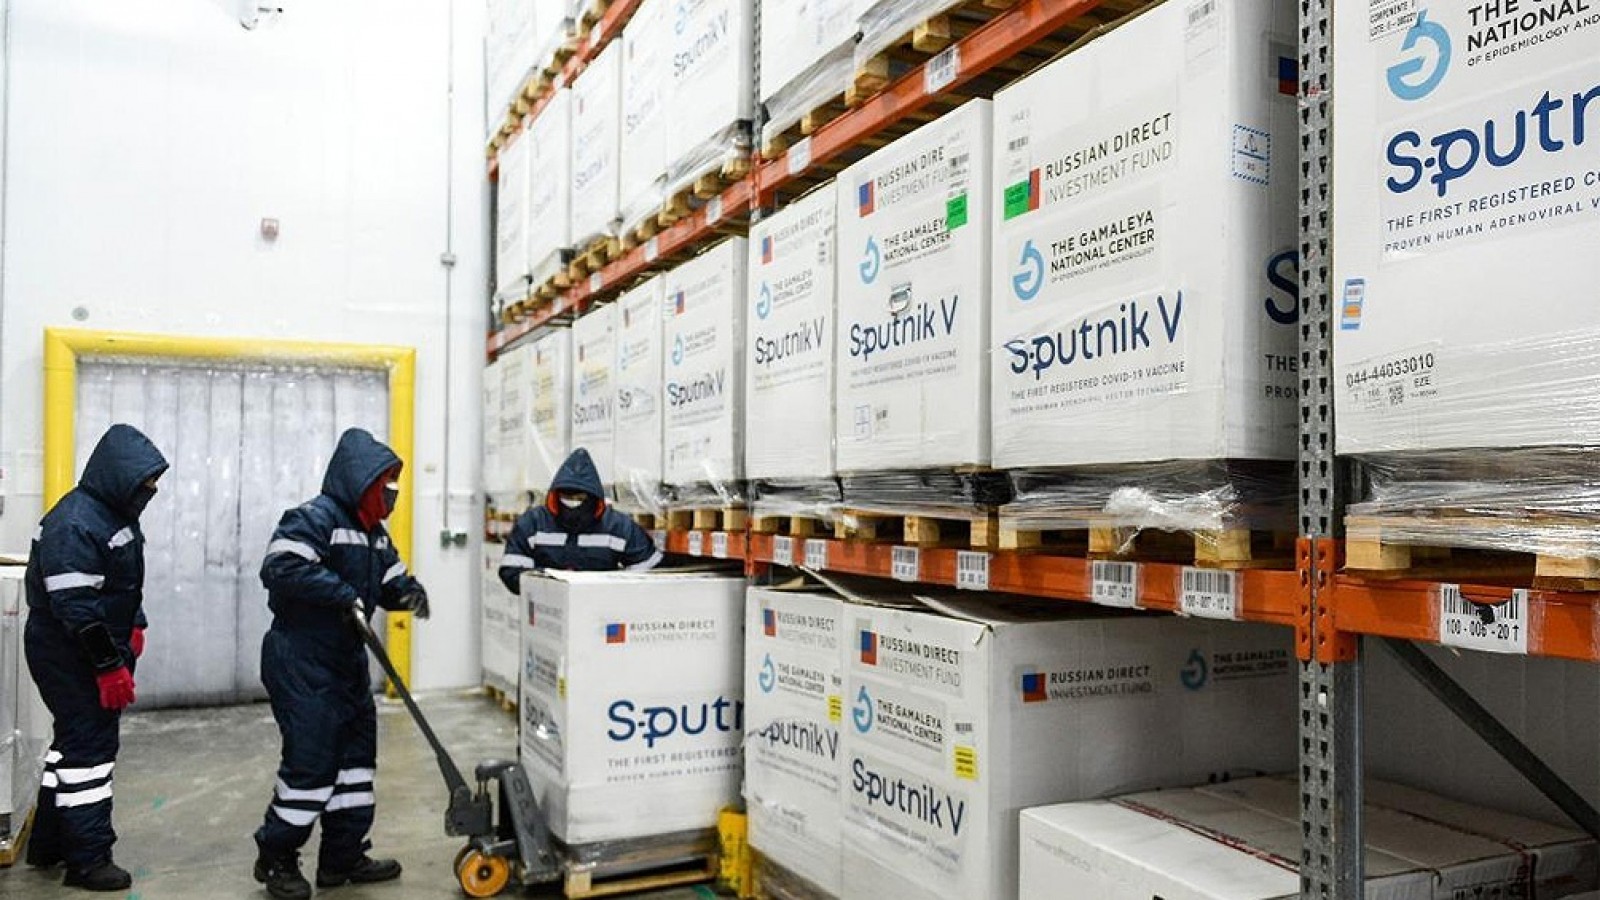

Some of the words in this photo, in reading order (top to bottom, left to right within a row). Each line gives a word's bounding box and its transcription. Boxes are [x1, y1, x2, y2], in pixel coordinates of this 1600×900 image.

[1468, 0, 1519, 26] THE
[1468, 0, 1590, 52] NATIONAL
[1467, 55, 1482, 67] OF
[1485, 24, 1570, 62] EPIDEMIOLOGY
[1046, 140, 1108, 180] RUSSIAN
[1114, 113, 1171, 152] DIRECT
[877, 160, 917, 190] RUSSIAN
[1046, 157, 1127, 204] INVESTMENT
[1133, 141, 1171, 173] FUND
[1387, 215, 1414, 232] THE
[1420, 202, 1463, 224] FIRST
[1469, 176, 1575, 213] REGISTERED
[884, 234, 900, 246] THE
[1051, 237, 1074, 257] THE
[1080, 210, 1154, 247] GAMALEYA
[1385, 233, 1431, 252] PROVEN
[1437, 223, 1483, 241] HUMAN
[1490, 201, 1583, 230] ADENOVIRAL
[1051, 246, 1106, 273] NATIONAL
[1109, 228, 1155, 254] CENTER
[755, 321, 811, 368] Sputnik
[814, 316, 824, 348] V
[850, 303, 936, 362] Sputnik
[941, 294, 958, 335] V
[1003, 301, 1150, 380] Sputnik
[1157, 290, 1183, 343] V
[1146, 361, 1185, 377] VACCINE
[1265, 354, 1298, 372] THE
[1346, 352, 1434, 388] 044-44033010
[630, 621, 675, 631] RUSSIAN
[678, 619, 715, 630] DIRECT
[880, 635, 920, 657] RUSSIAN
[924, 645, 959, 665] DIRECT
[937, 667, 961, 688] FUND
[1051, 671, 1104, 684] RUSSIAN
[1107, 666, 1150, 680] DIRECT
[1051, 684, 1118, 699] INVESTMENT
[878, 699, 893, 714] THE
[896, 705, 942, 730] GAMALEYA
[878, 713, 912, 733] NATIONAL
[913, 725, 943, 743] CENTER
[826, 728, 838, 761] V
[853, 758, 943, 829] Sputnik
[947, 795, 964, 836] V
